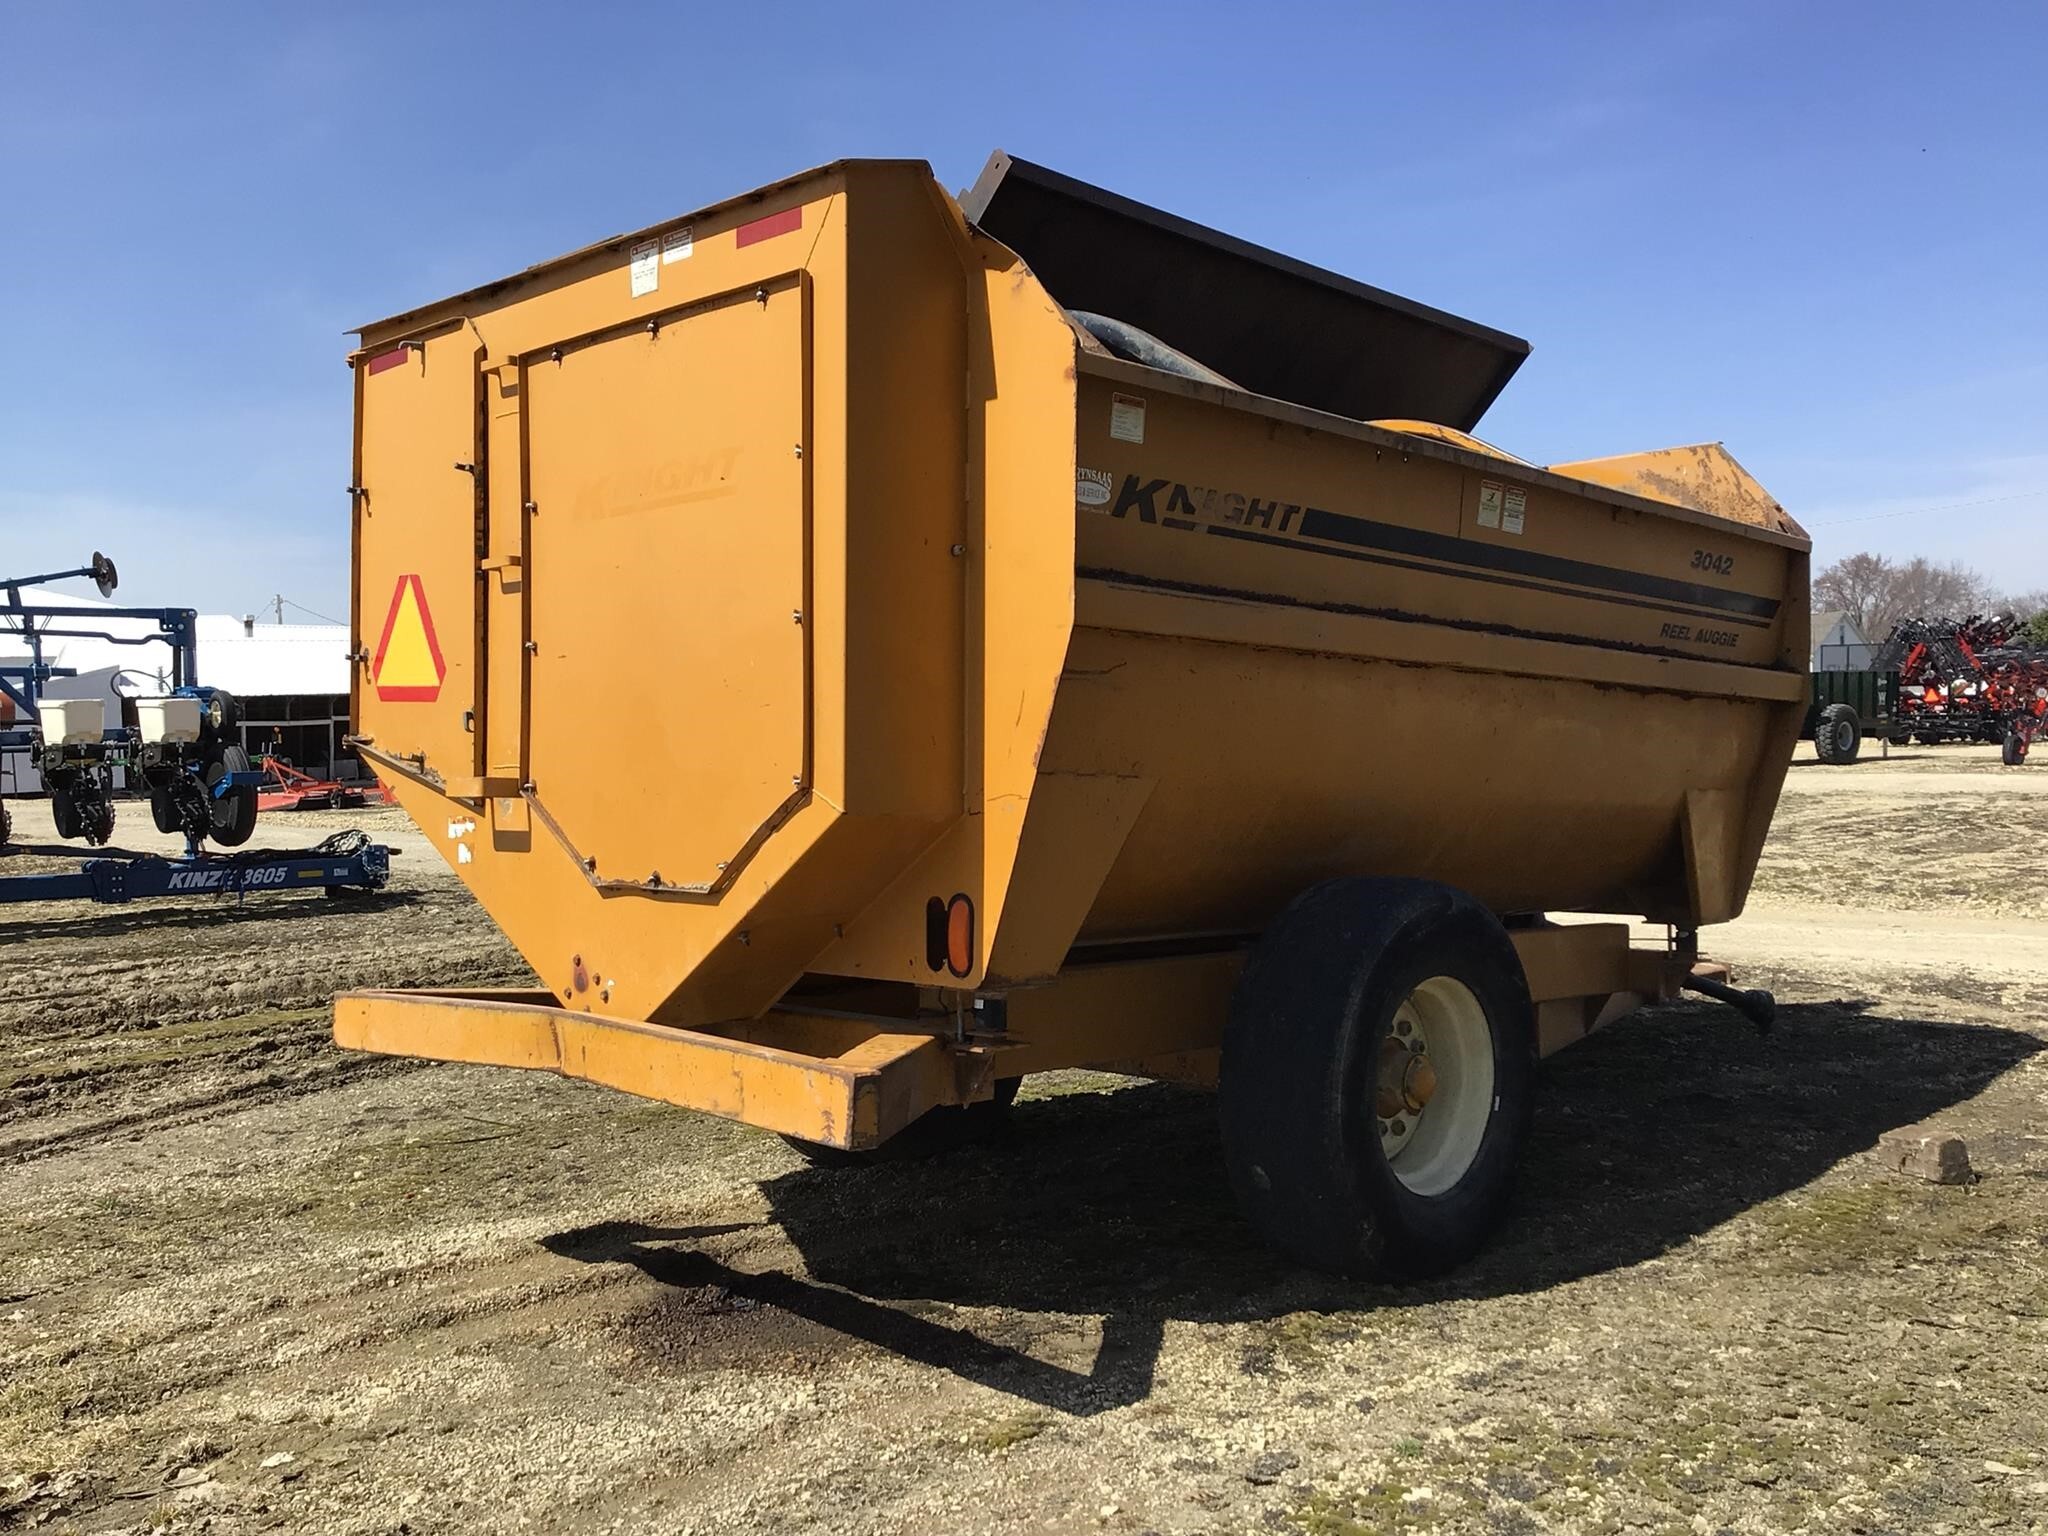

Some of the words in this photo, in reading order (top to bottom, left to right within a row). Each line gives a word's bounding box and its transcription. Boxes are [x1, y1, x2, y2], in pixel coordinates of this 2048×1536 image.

[1112, 474, 1301, 531] KNIGHT
[1691, 551, 1734, 575] 3042
[1660, 623, 1690, 641] REEL
[1695, 629, 1739, 647] AUGGIE
[241, 867, 288, 885] 3605
